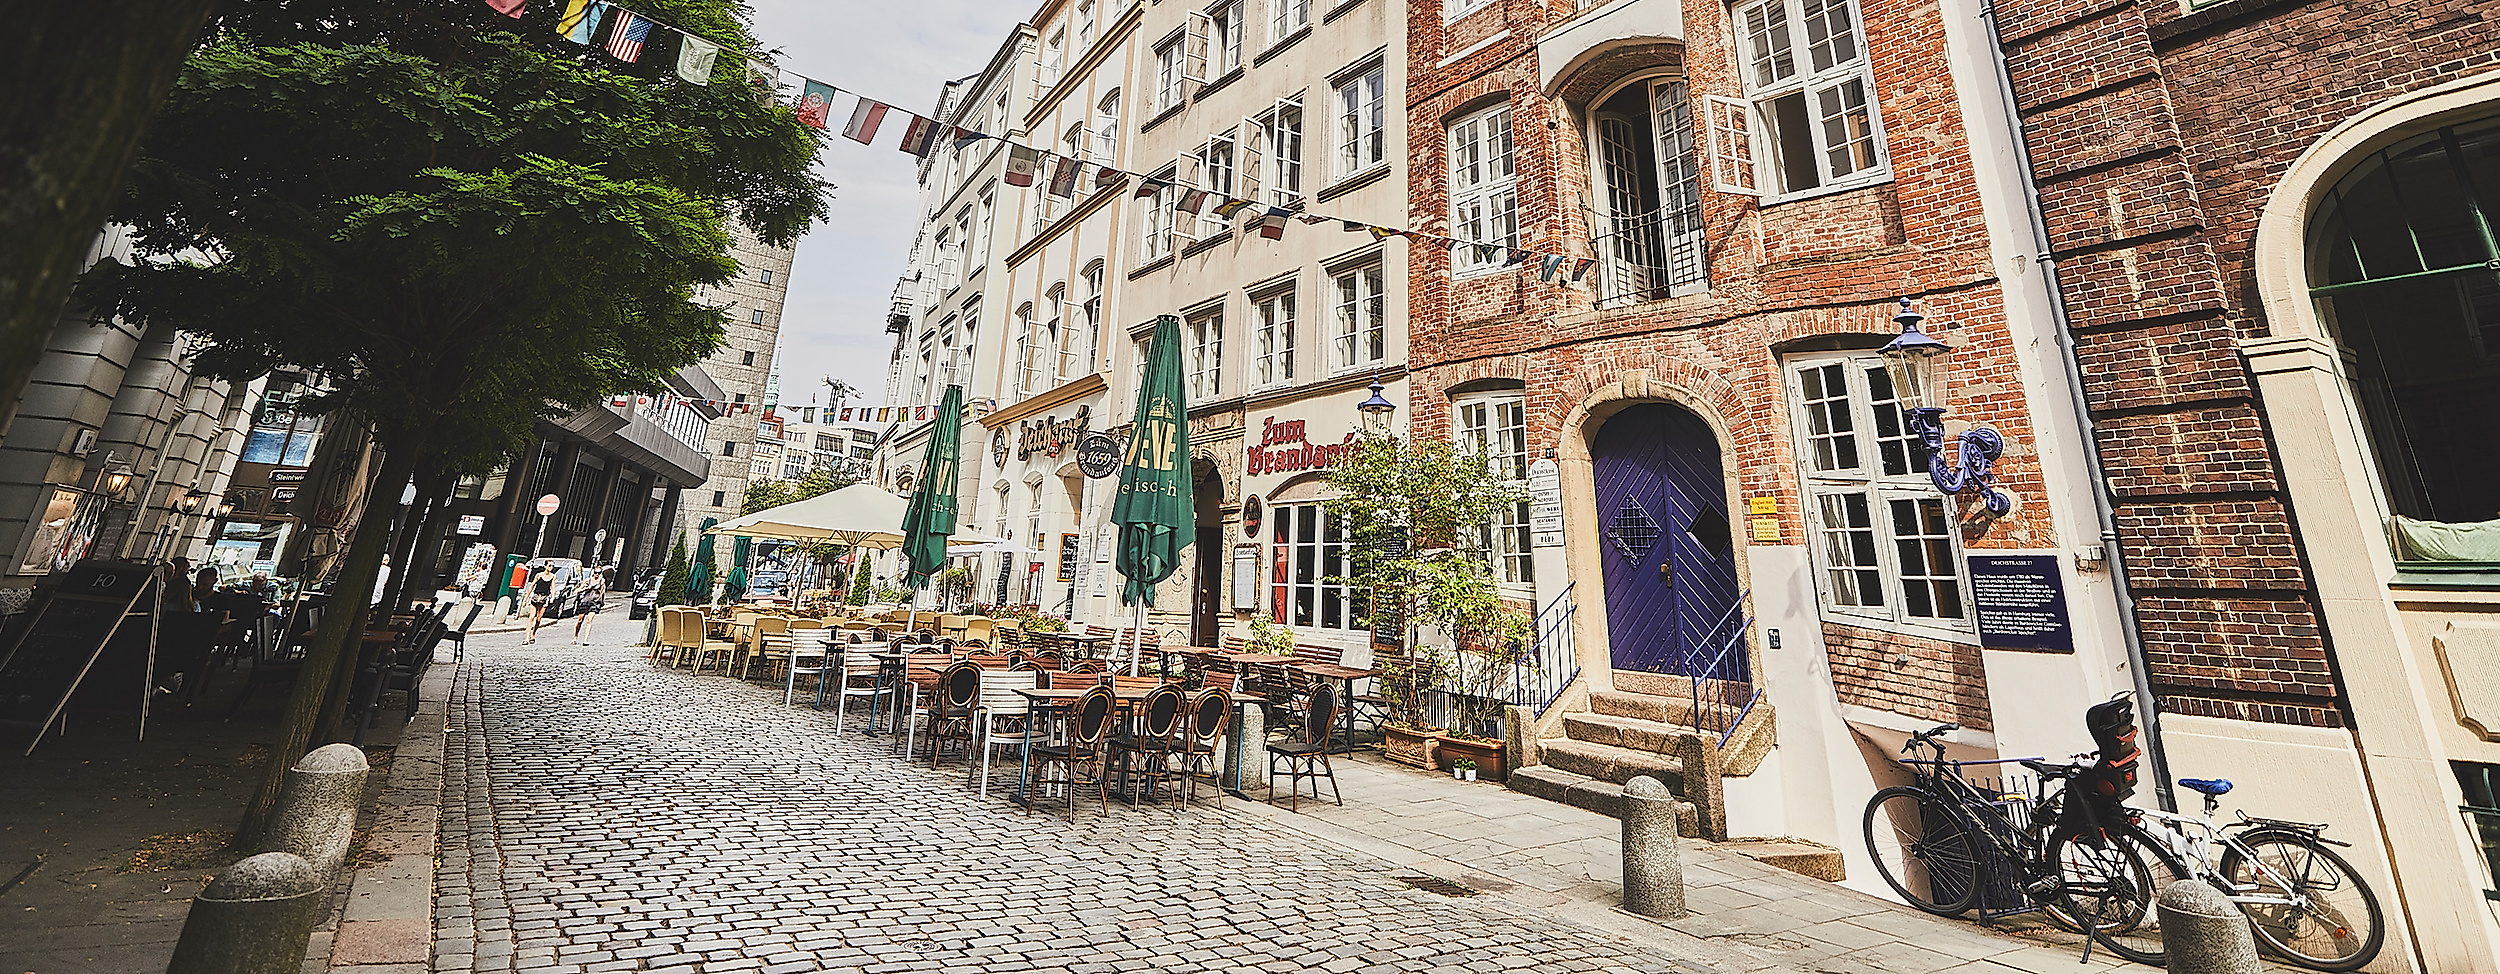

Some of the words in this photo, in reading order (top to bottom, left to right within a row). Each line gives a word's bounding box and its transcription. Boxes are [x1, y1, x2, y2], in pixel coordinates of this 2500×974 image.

[1262, 416, 1306, 446] Zum
[1086, 450, 1112, 466] 1659
[1546, 449, 1554, 458] 27
